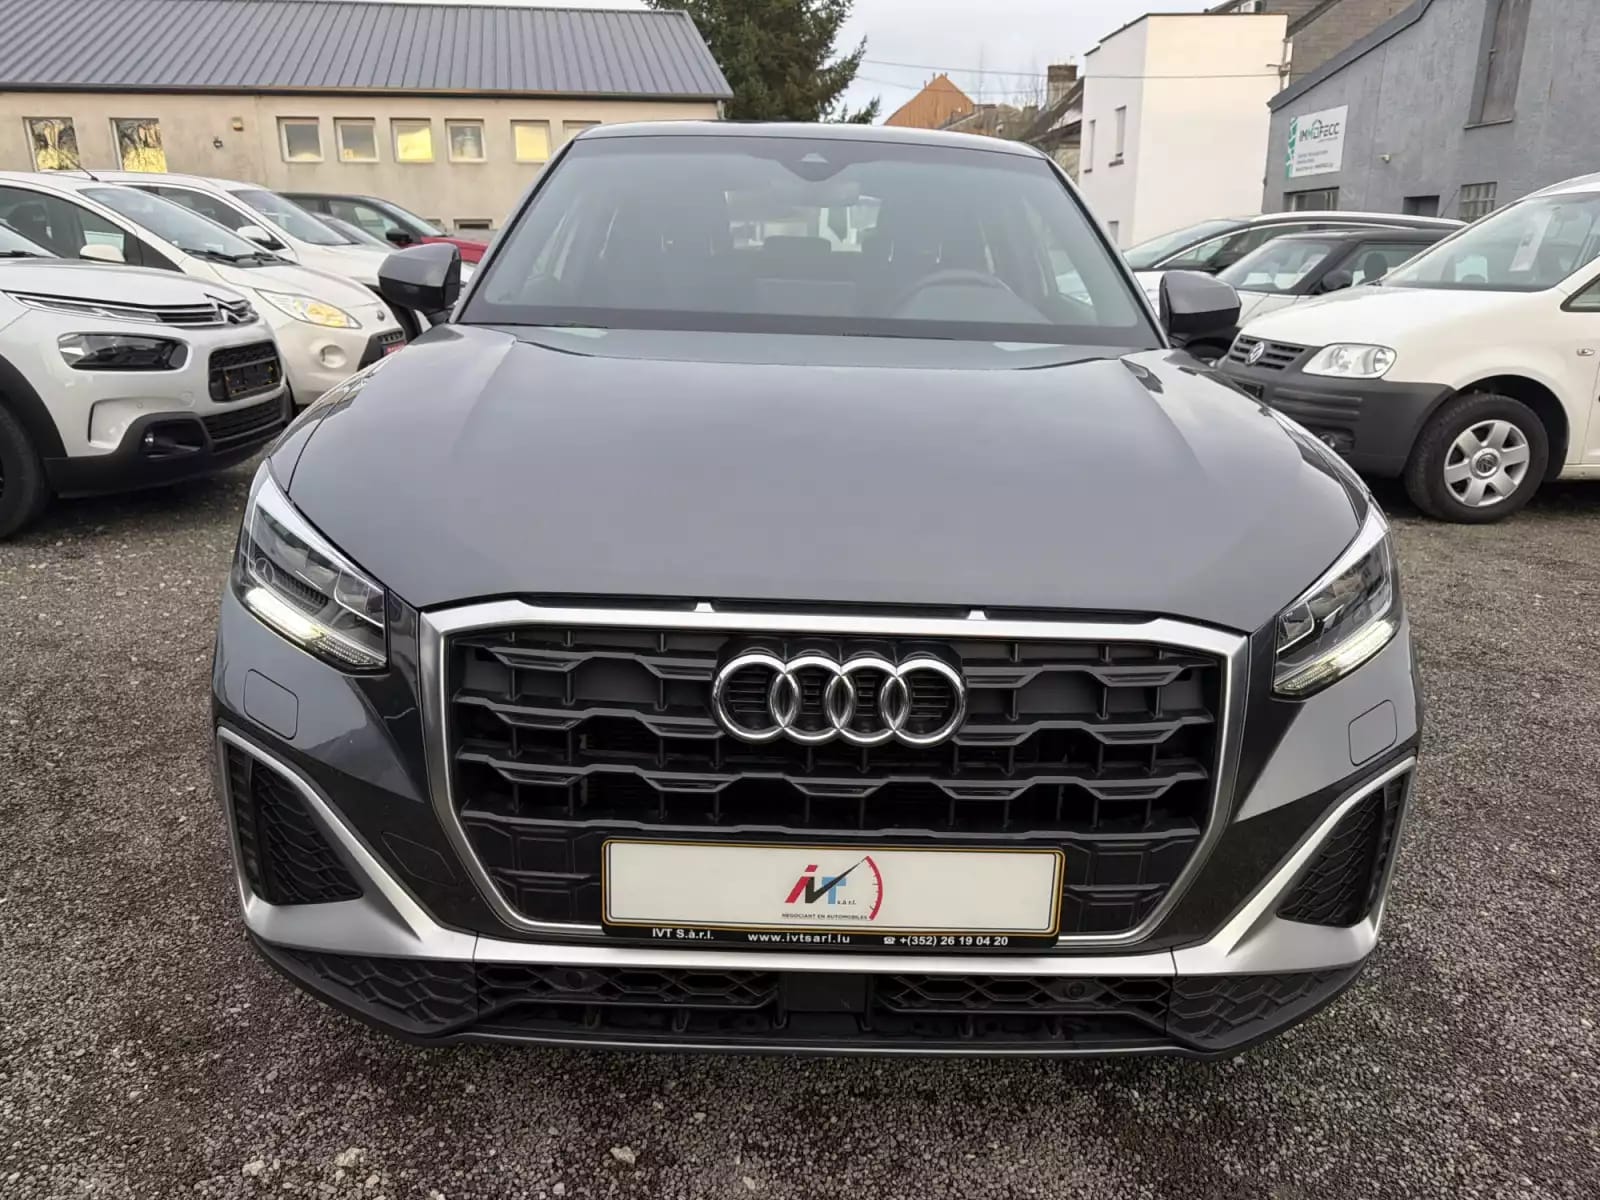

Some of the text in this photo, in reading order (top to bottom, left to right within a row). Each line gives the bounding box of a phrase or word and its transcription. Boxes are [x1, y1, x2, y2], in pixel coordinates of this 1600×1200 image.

[652, 927, 673, 938] IVT
[747, 933, 850, 943] www.ivtsarl.lu
[899, 936, 1009, 947] +(352) 26 19 04 20
